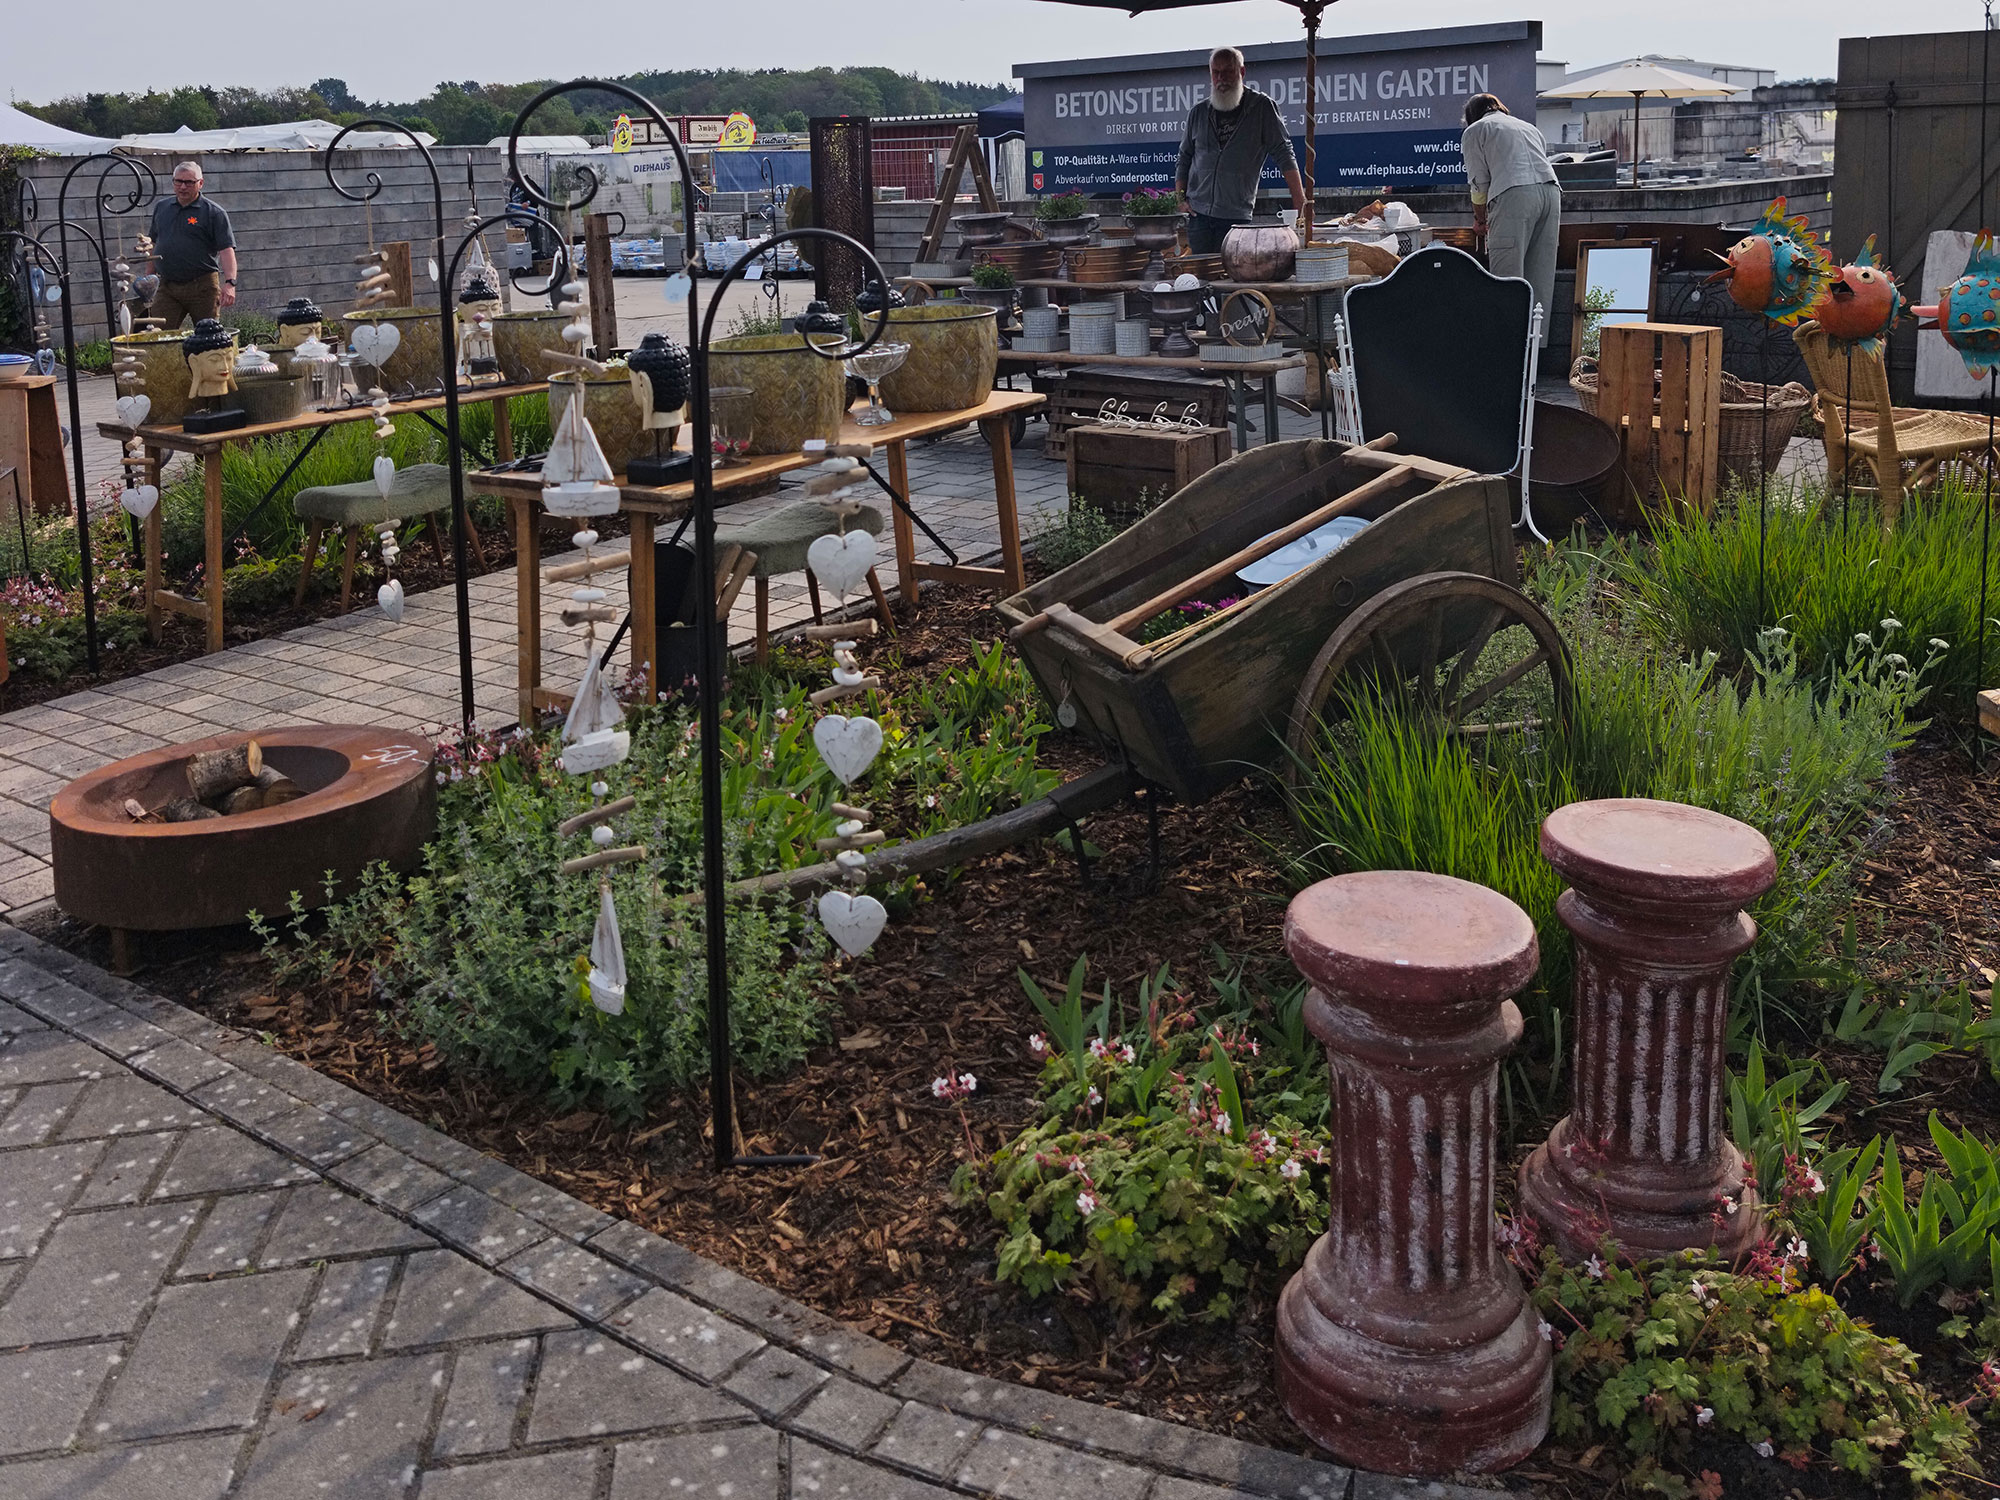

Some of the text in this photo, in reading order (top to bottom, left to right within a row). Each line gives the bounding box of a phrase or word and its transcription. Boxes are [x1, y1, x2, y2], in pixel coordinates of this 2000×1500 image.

[1055, 84, 1206, 118] BETONSTEINE
[1376, 64, 1489, 99] GARTEN
[1106, 123, 1138, 135] DIREKT
[1139, 122, 1158, 133] VOR
[1160, 121, 1178, 132] ORT
[1299, 113, 1329, 125] JZT
[1332, 111, 1382, 123] BERATEN
[1383, 108, 1431, 121] LASSEN!
[1413, 140, 1463, 154] www.die
[633, 162, 671, 173] DIEPHAUS
[1054, 152, 1180, 166] TOP-Qualität: A-Ware für höchs
[1055, 174, 1094, 185] Abverkauf
[1095, 176, 1109, 184] von
[1110, 172, 1169, 185] Sonderposten
[1261, 167, 1285, 179] eich
[1219, 306, 1270, 338] Dream
